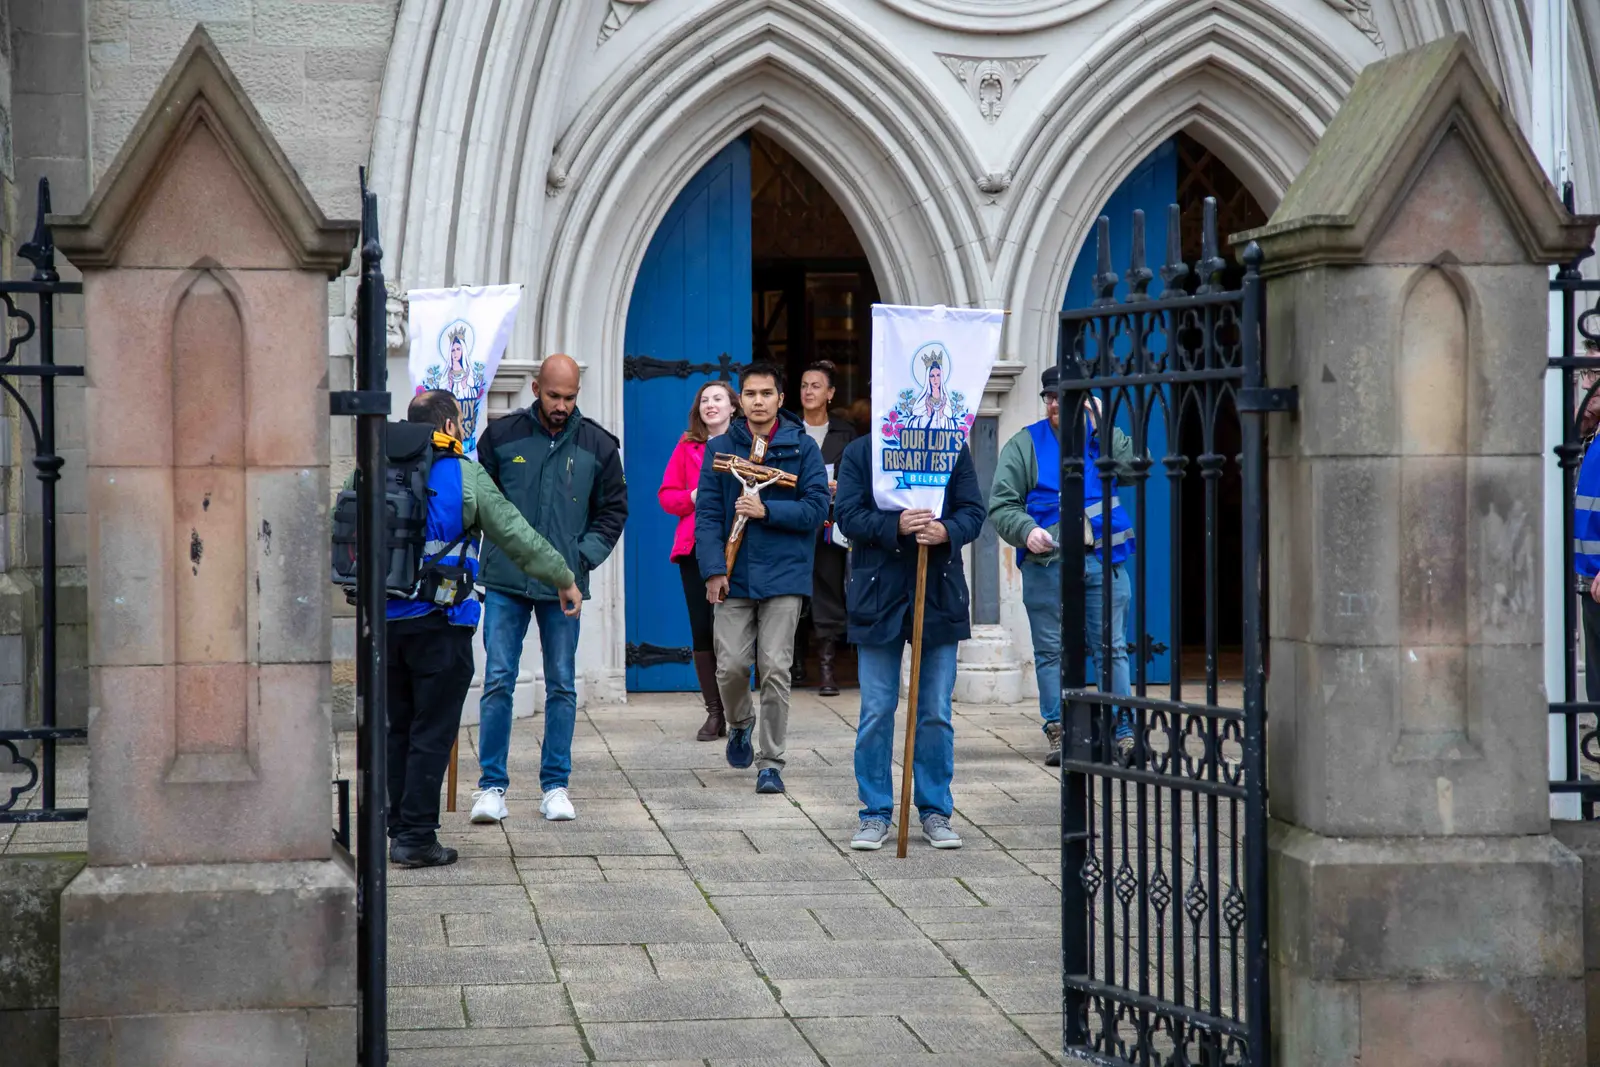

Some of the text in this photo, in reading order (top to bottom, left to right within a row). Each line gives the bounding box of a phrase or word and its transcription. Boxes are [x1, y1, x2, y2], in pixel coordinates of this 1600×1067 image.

[901, 429, 963, 451] OUR LADY'S
[884, 449, 928, 470] ROSARY
[910, 474, 950, 483] BELFAS
